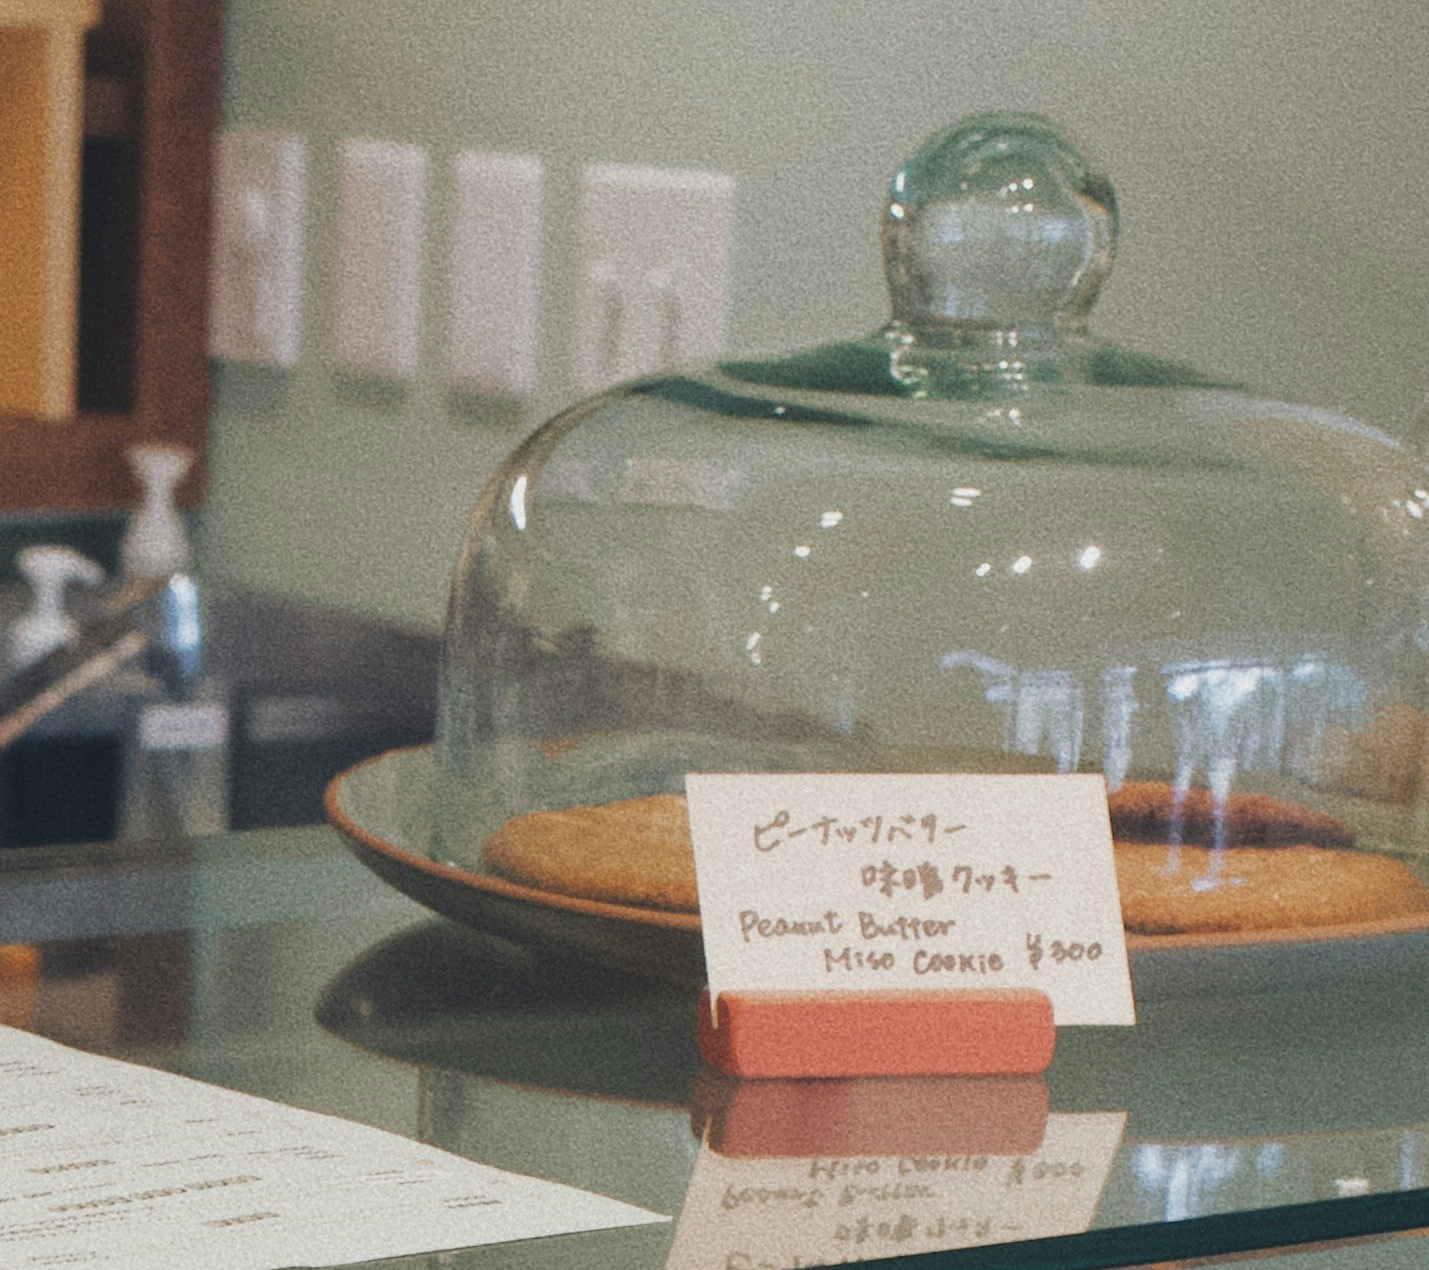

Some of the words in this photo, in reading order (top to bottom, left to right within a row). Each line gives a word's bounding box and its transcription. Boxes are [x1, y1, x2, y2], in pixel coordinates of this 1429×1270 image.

[753, 809, 967, 853] ピーナッツバター
[861, 860, 1053, 899] 味噌クッキー
[740, 910, 842, 945] Peanut
[859, 910, 956, 941] Butter
[824, 948, 896, 974] Miso
[913, 947, 1005, 976] Cookie
[1026, 931, 1103, 970] ¥300
